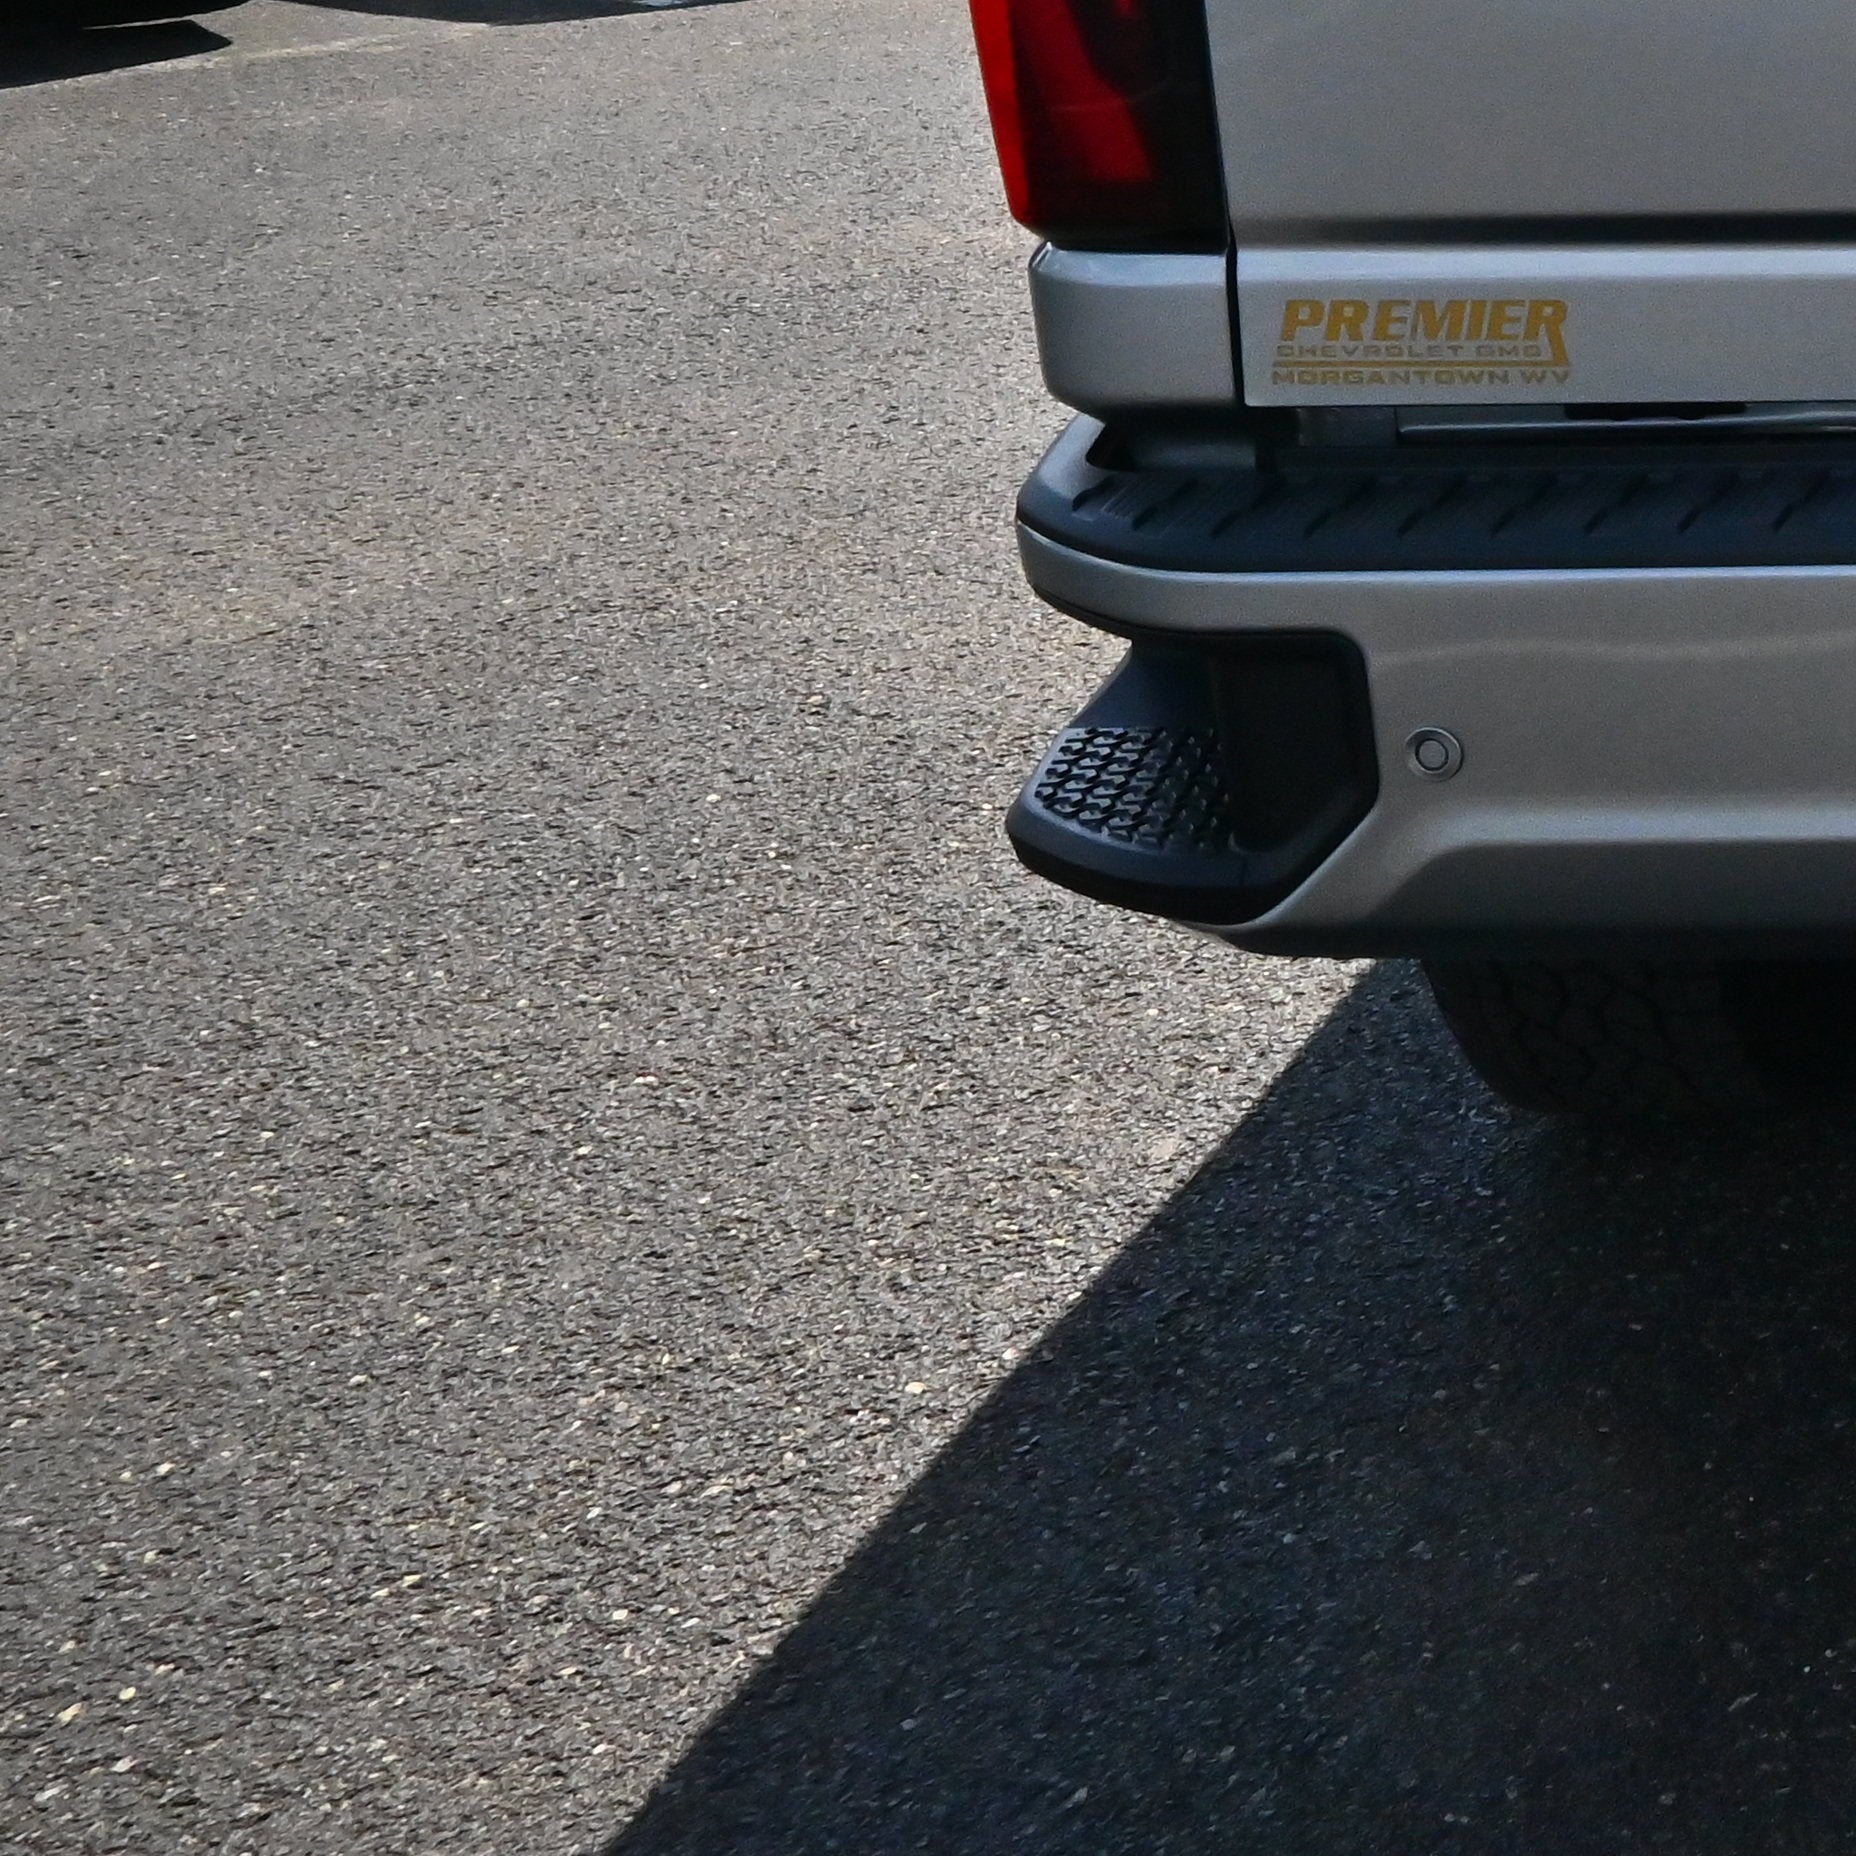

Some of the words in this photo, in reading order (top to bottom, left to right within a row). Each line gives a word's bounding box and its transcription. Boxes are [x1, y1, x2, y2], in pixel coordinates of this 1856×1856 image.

[1279, 299, 1569, 366] PREMIER
[1276, 344, 1465, 358] CHEVROLET
[1475, 343, 1543, 358] GMC
[1271, 369, 1510, 385] MORGANTOWN
[1519, 367, 1570, 384] WV
